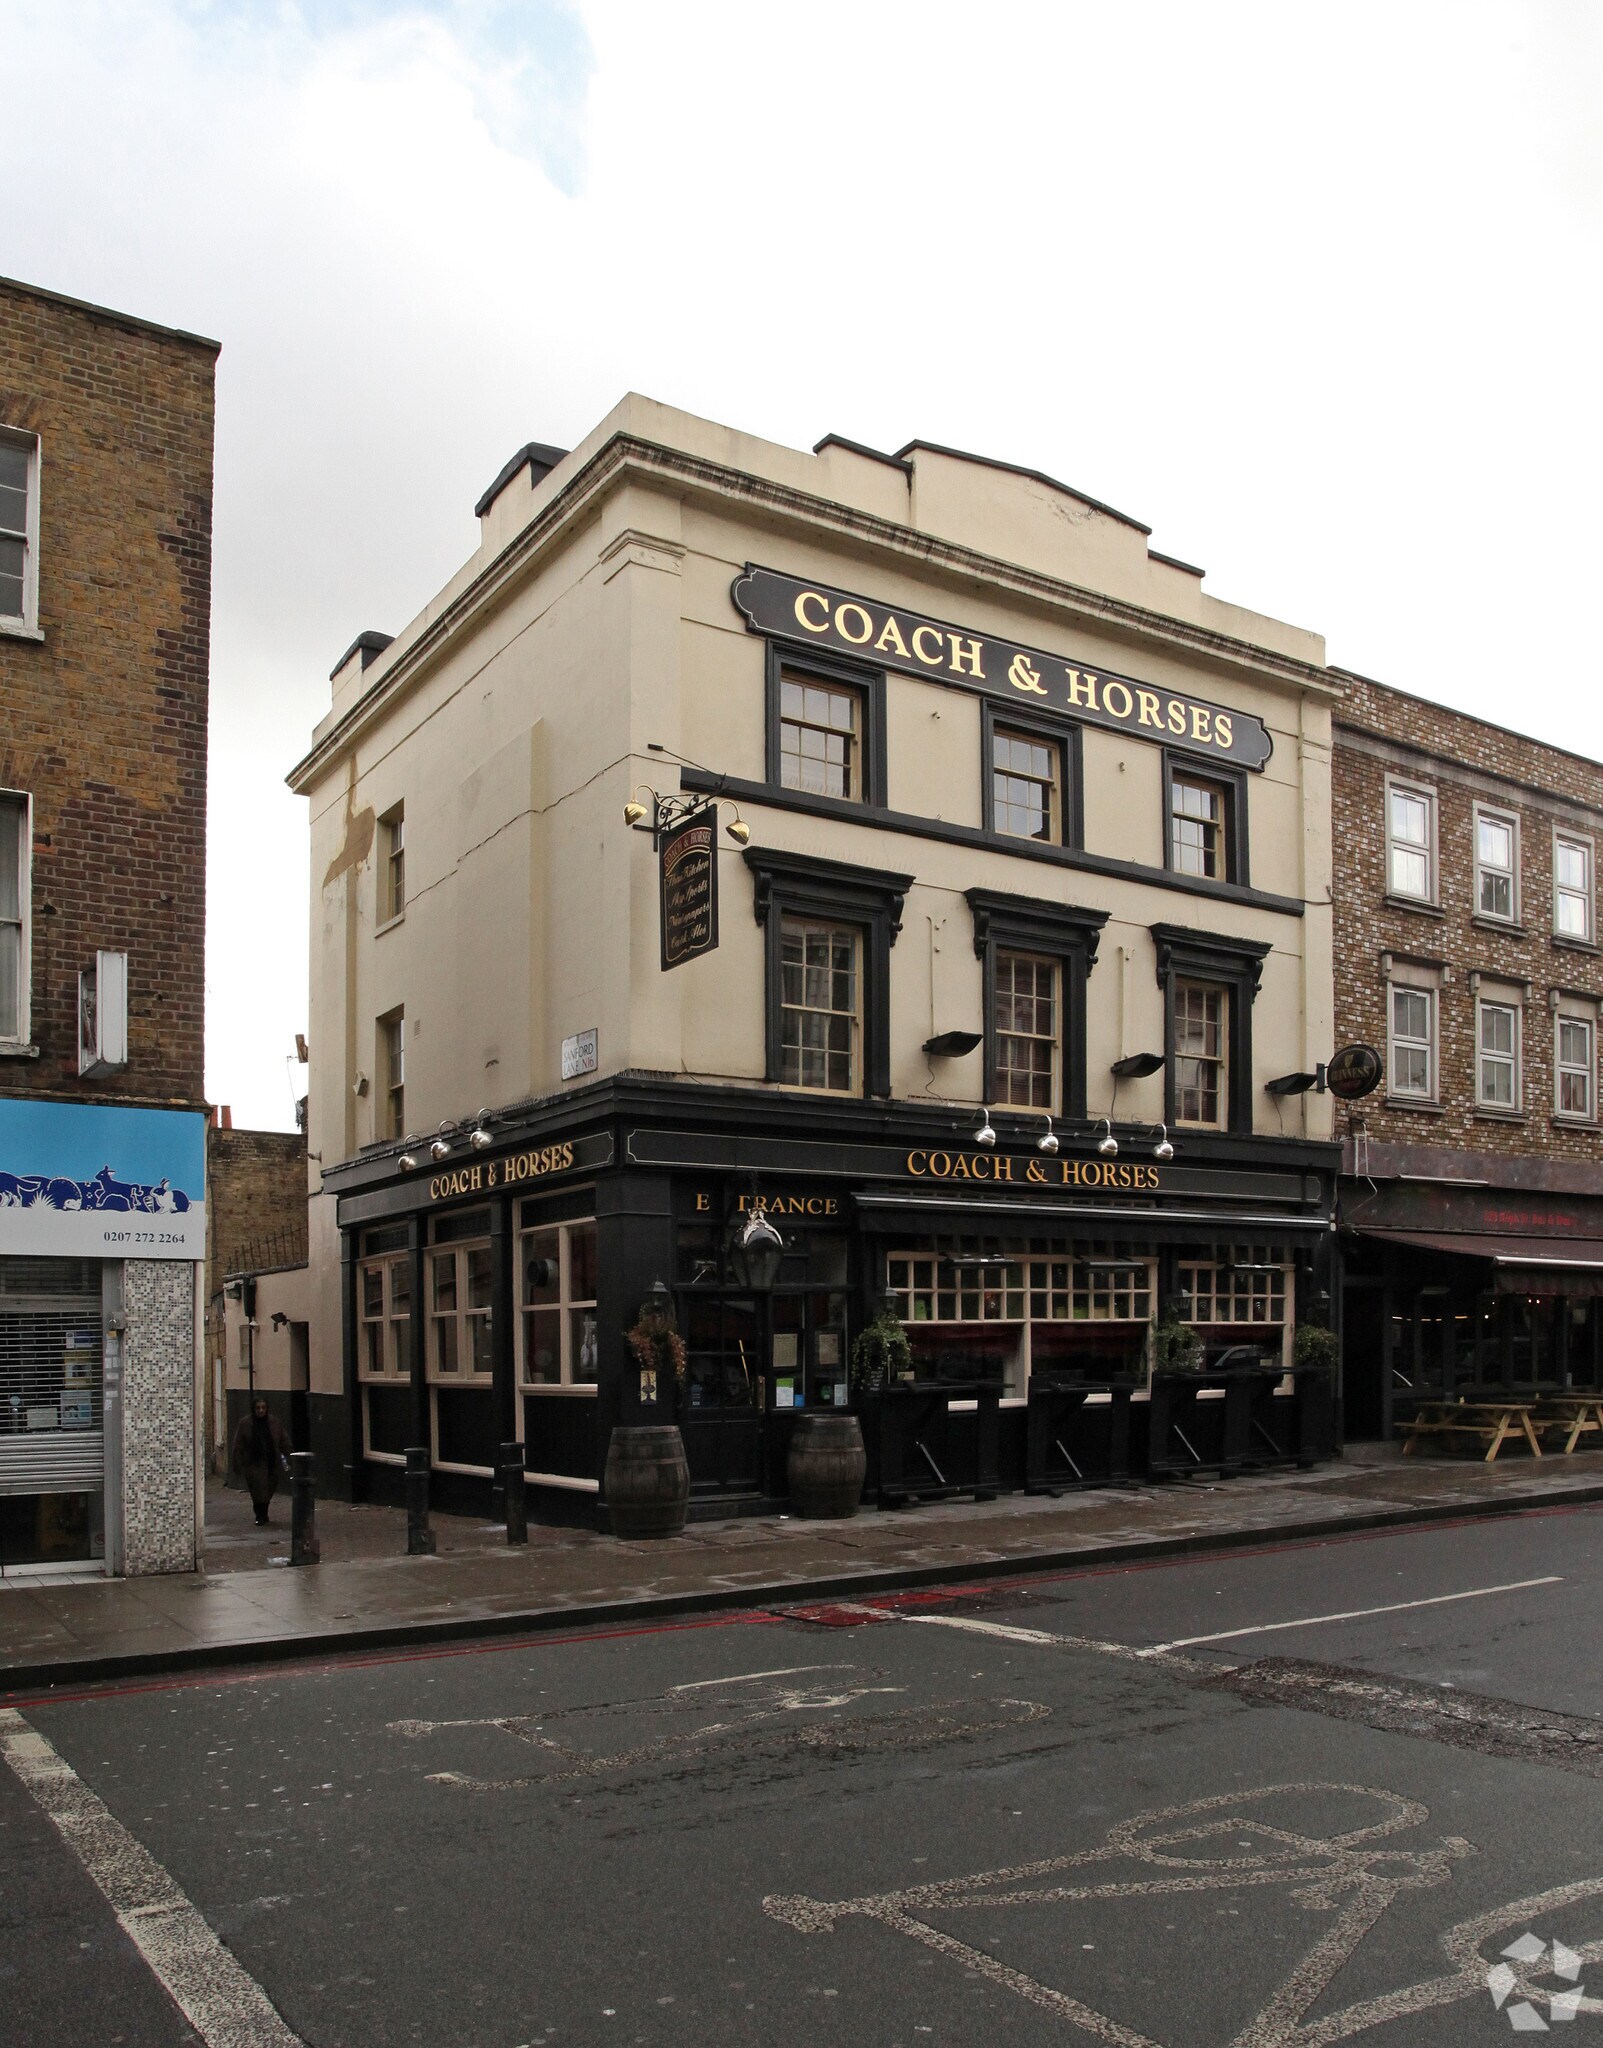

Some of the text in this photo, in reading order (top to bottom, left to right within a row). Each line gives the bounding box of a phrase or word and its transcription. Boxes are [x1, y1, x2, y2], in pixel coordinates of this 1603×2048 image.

[794, 590, 1234, 749] COACH & HORSES
[664, 839, 683, 868] COACH
[690, 830, 711, 844] HORSES
[430, 1141, 574, 1200] COACH & HORSES
[907, 1150, 1160, 1189] COACH & HORSES
[696, 1193, 839, 1215] ETRANCE
[103, 1231, 186, 1244] 0207 272 2264
